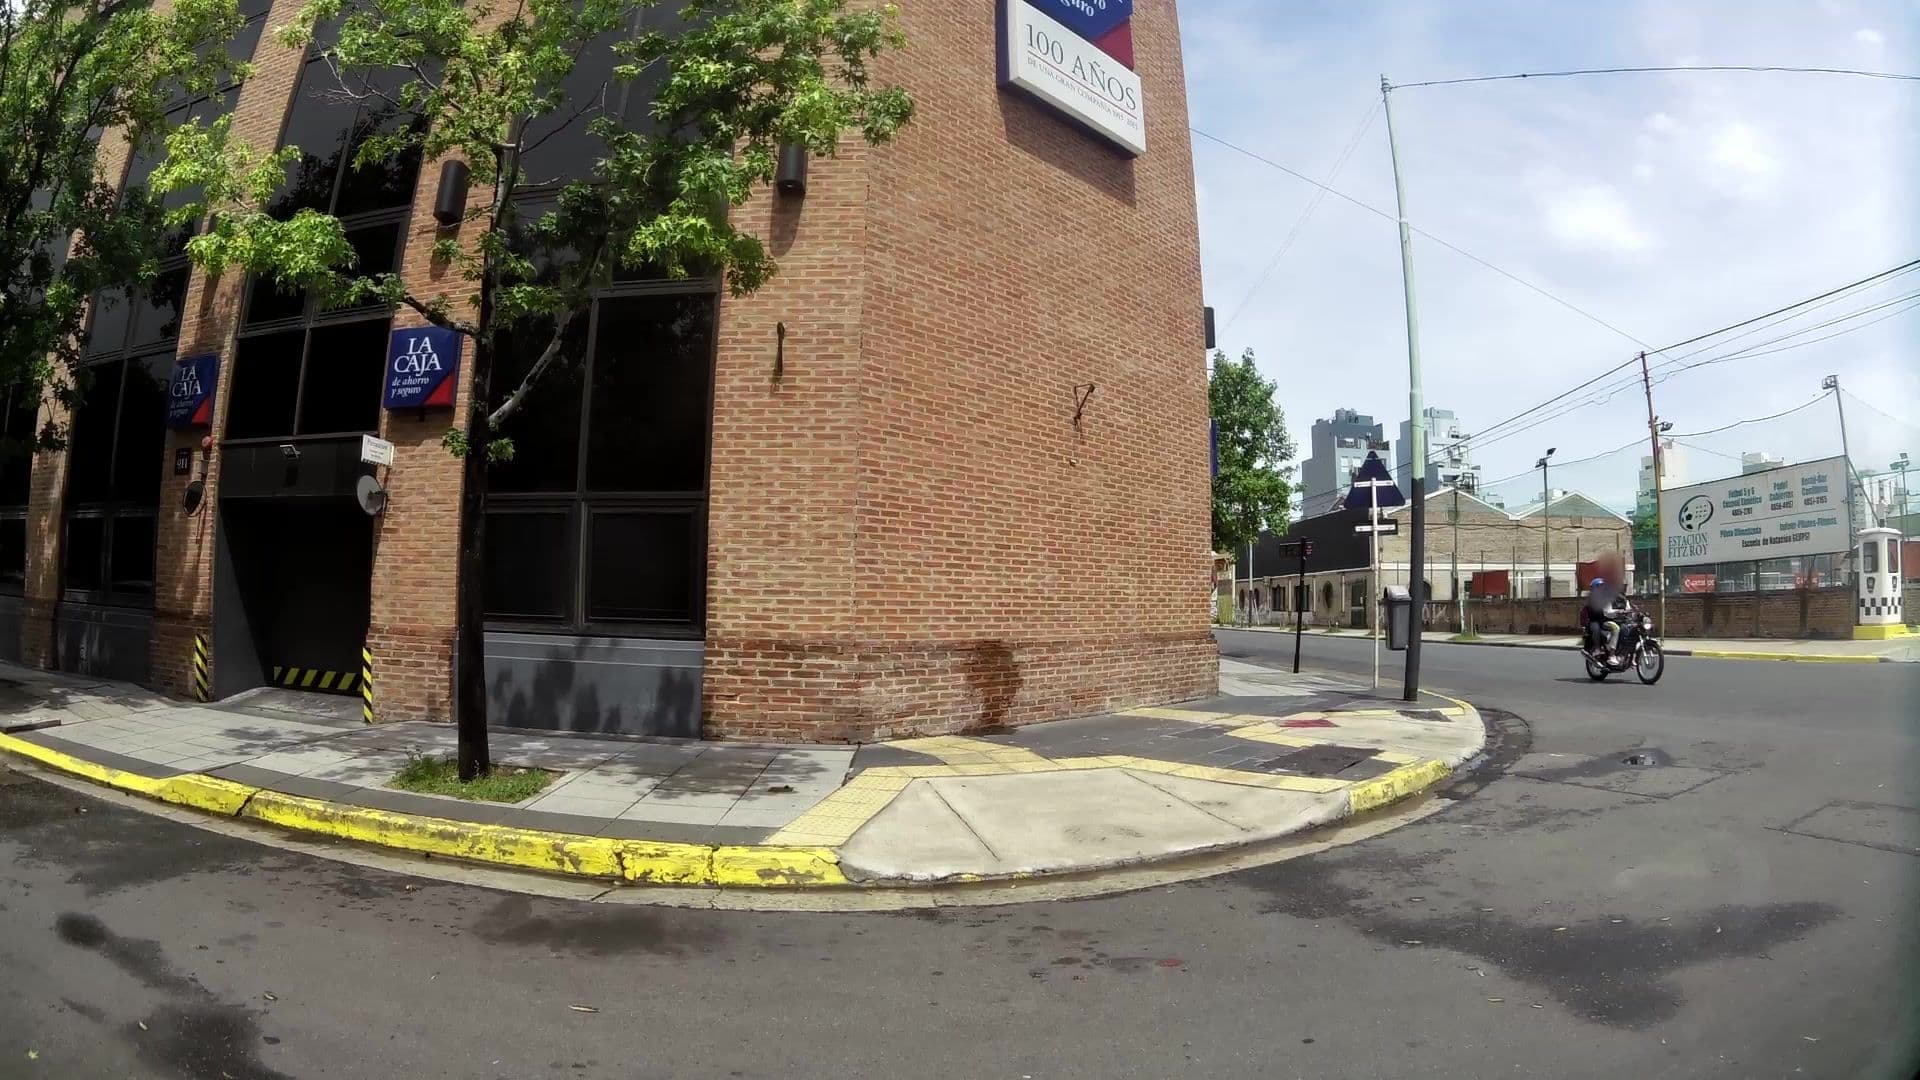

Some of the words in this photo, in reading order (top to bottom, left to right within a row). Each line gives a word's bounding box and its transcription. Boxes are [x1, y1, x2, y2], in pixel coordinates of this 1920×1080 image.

[1026, 23, 1064, 65] 100
[1072, 55, 1136, 111] AÑOS
[407, 336, 434, 355] LA
[181, 365, 197, 381] LA
[394, 353, 443, 376] CAJA
[172, 380, 203, 399] CAJA
[391, 377, 401, 387] de
[402, 376, 430, 386] ahorro
[397, 386, 422, 397] seguro
[1689, 544, 1708, 557] ROY
